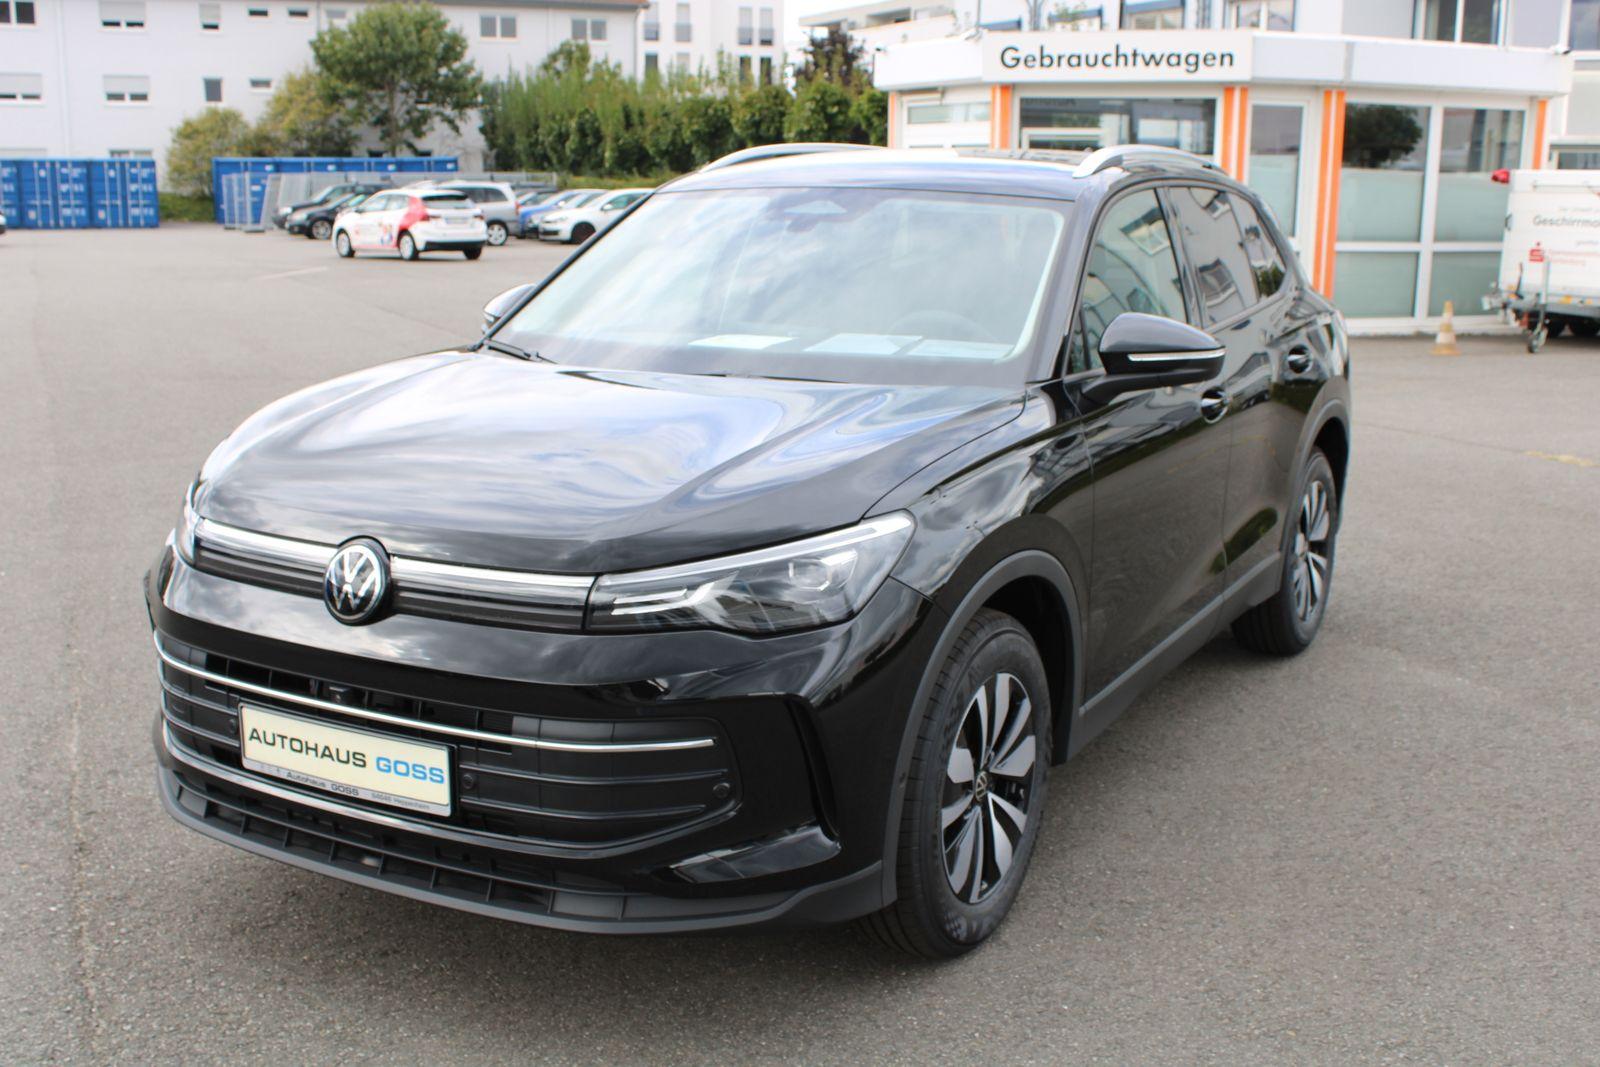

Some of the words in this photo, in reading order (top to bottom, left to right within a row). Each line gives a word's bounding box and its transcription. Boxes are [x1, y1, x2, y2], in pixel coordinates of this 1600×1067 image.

[1000, 44, 1235, 73] Gebrauchtwagen
[248, 727, 367, 769] AUTOHAUS
[375, 755, 445, 784] GOSS
[286, 771, 326, 788] Autohaus
[330, 783, 359, 796] GOSS
